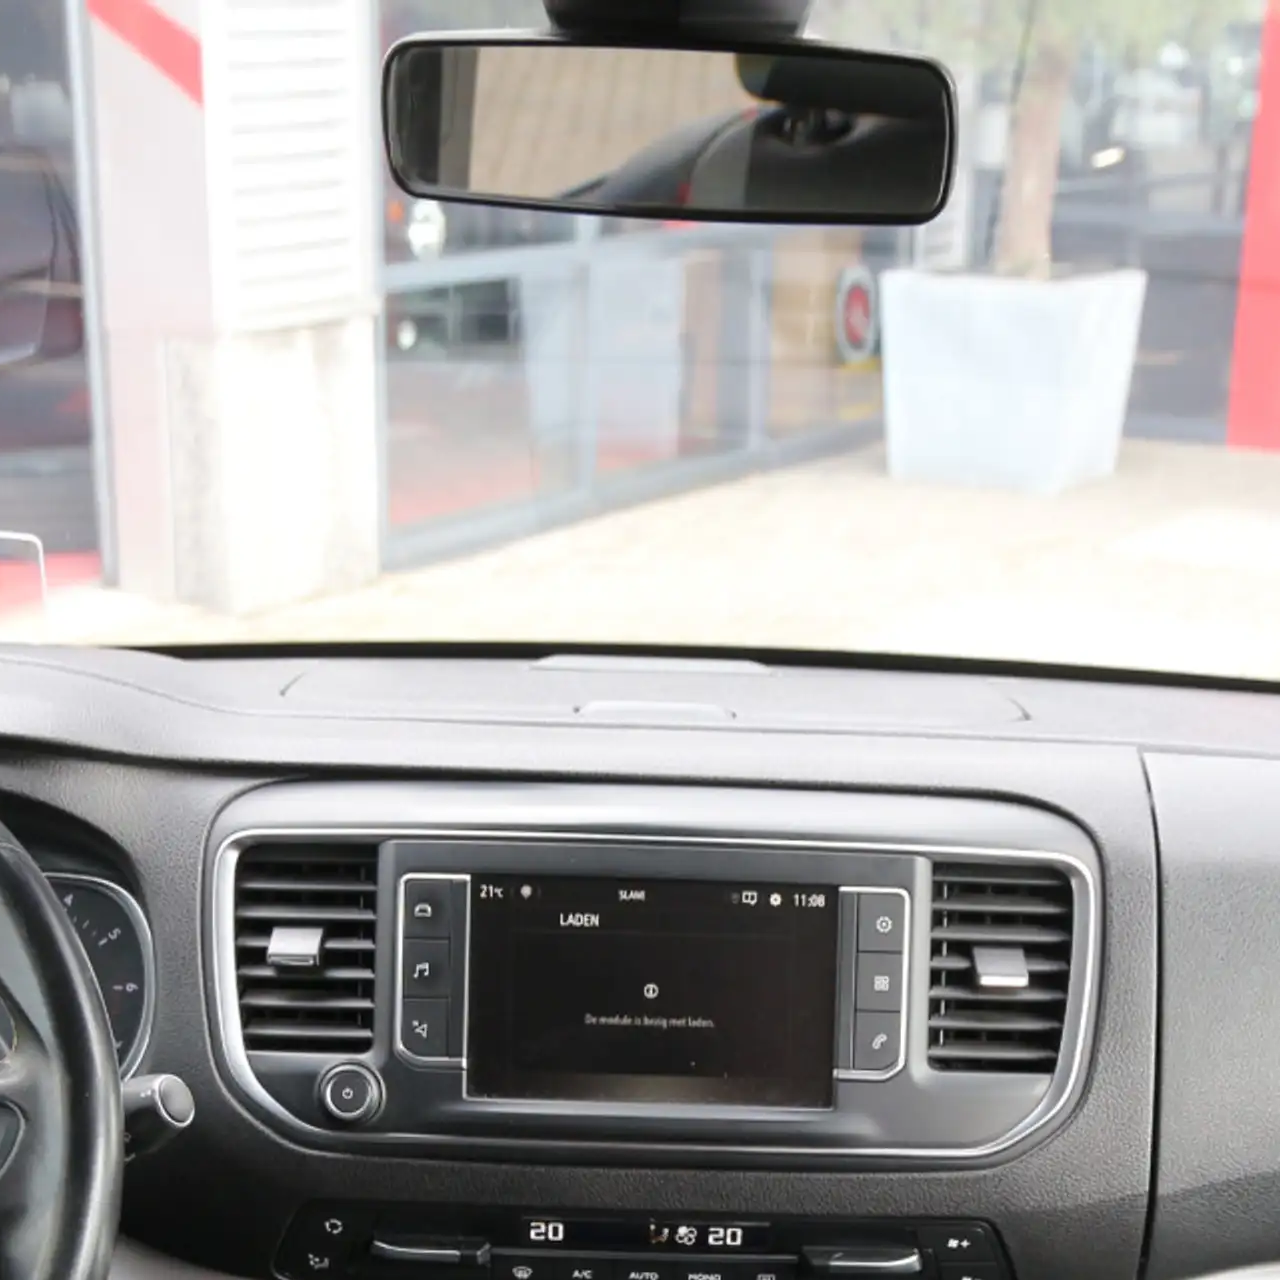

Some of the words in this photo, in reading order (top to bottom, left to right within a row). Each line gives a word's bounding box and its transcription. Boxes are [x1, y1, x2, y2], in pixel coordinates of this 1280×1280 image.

[559, 913, 600, 927] LADEN
[107, 927, 122, 941] 5
[125, 981, 139, 993] 6
[529, 1221, 565, 1242] 20
[707, 1227, 743, 1246] 20
[572, 1269, 593, 1280] A/C
